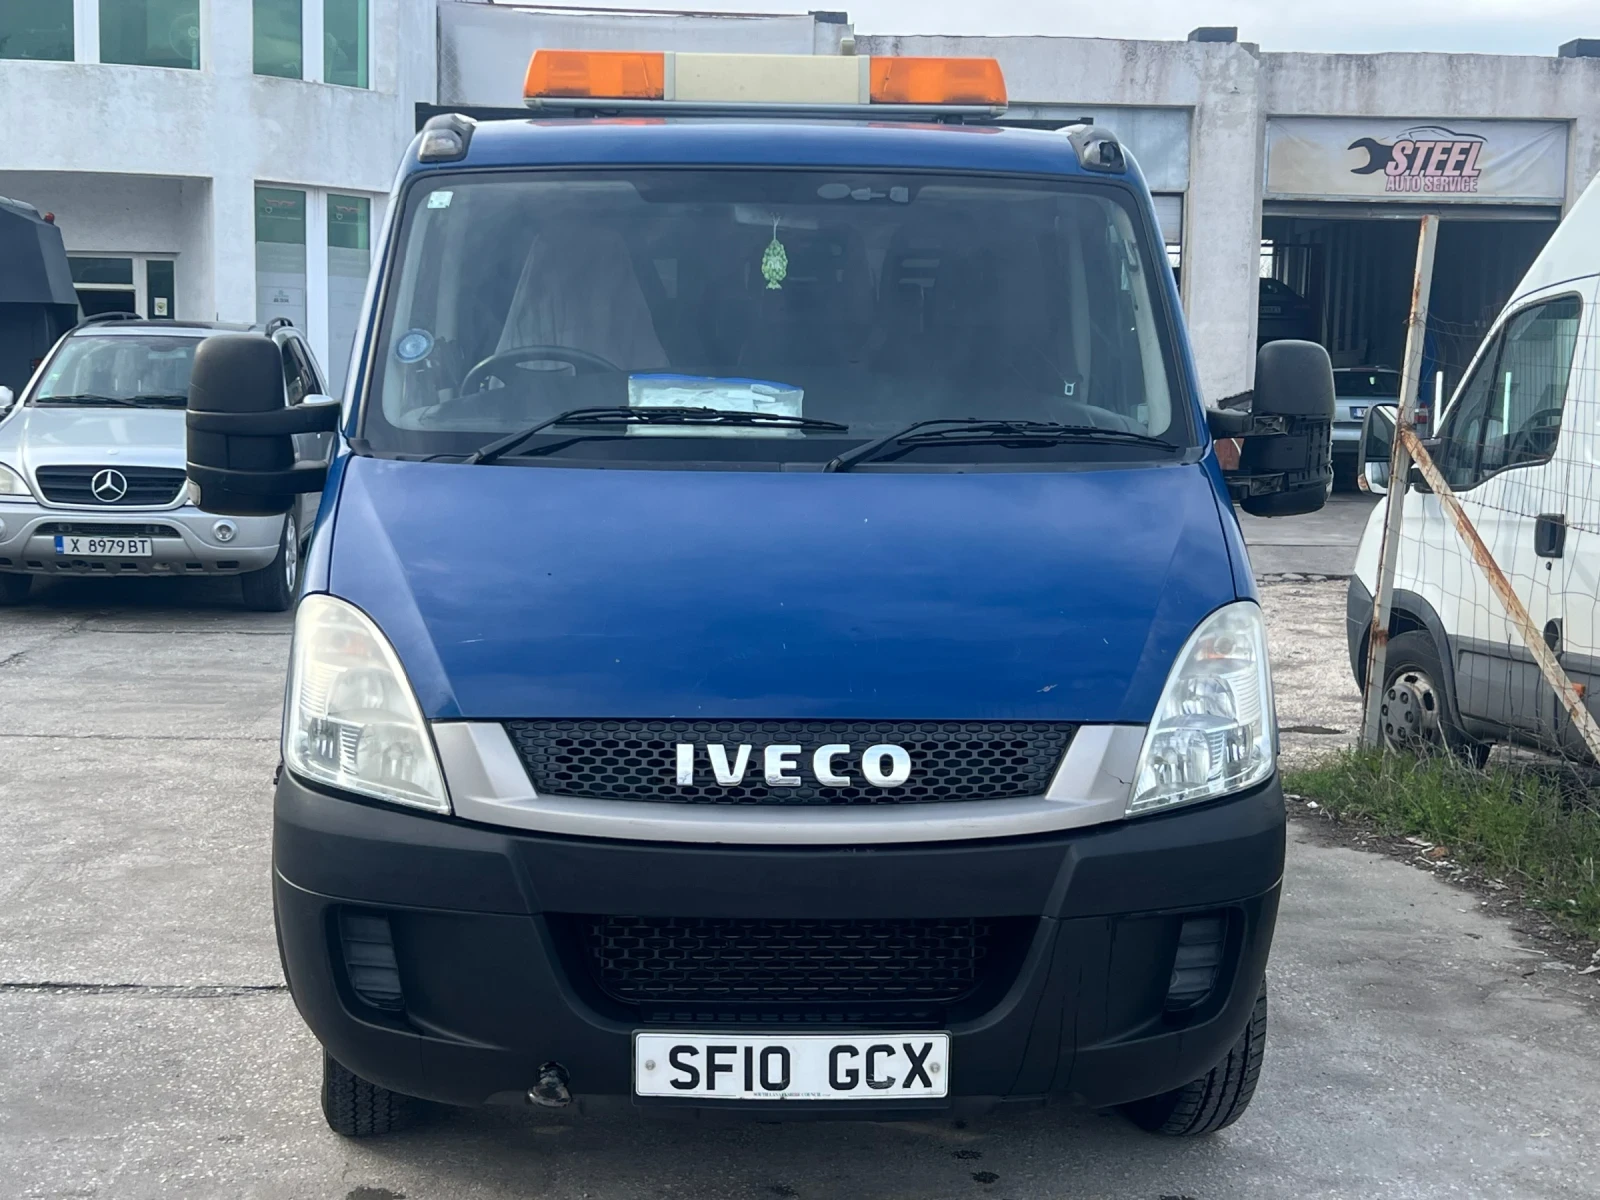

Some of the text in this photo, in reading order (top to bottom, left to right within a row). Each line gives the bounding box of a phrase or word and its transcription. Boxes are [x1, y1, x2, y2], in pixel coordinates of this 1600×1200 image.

[1384, 139, 1483, 176] STEEL
[1385, 175, 1478, 192] AUTO SERVICE
[71, 539, 148, 553] X 8979 BT
[676, 743, 912, 788] IVECO
[669, 1042, 933, 1091] SF10 GCX
